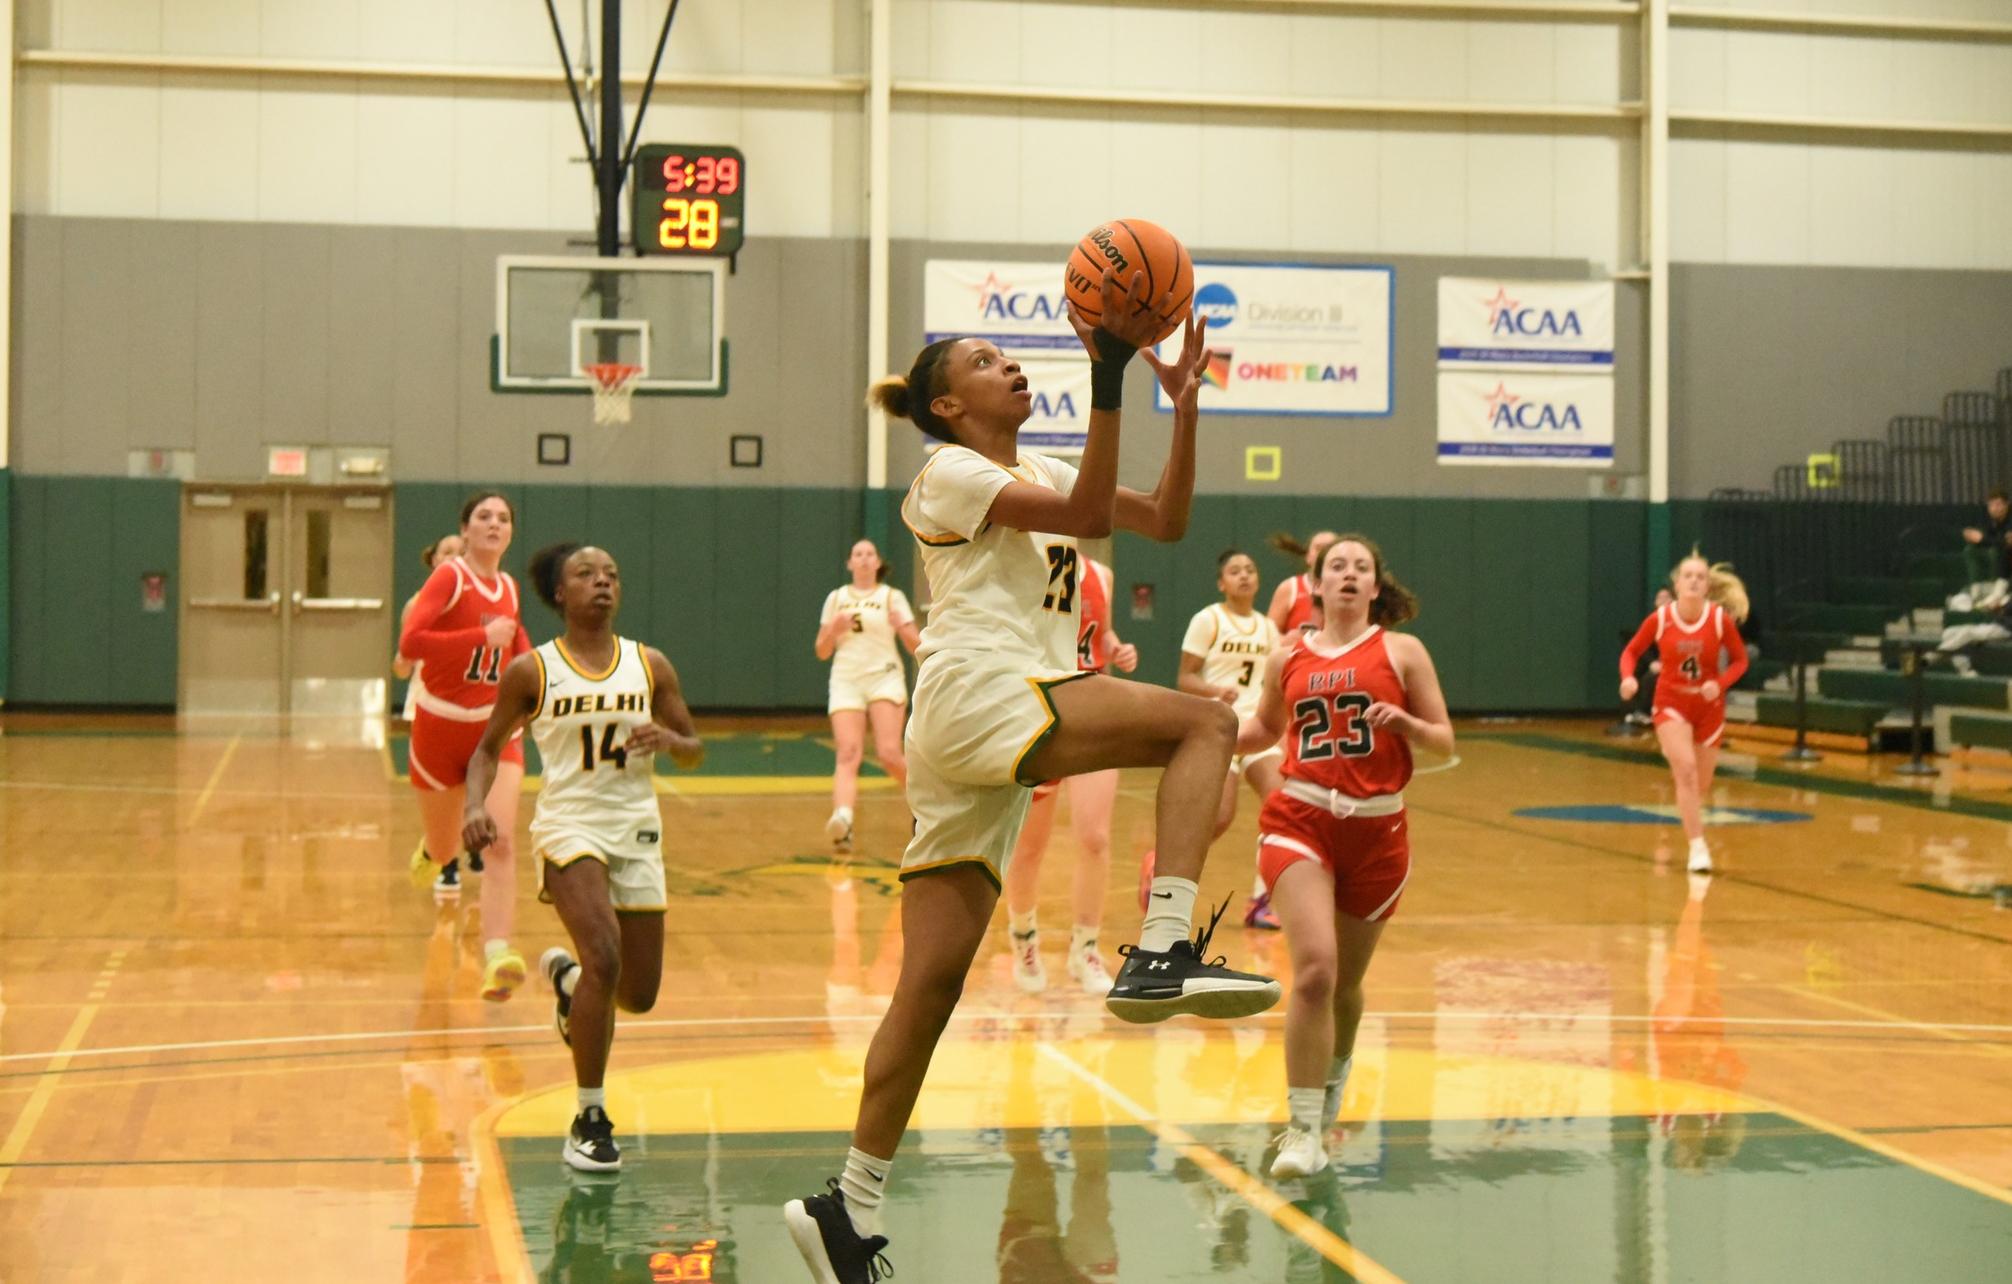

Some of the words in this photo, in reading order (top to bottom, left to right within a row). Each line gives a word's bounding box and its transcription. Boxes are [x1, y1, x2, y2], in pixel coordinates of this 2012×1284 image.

[663, 155, 739, 195] 5:39
[659, 198, 719, 249] 28
[1493, 308, 1583, 336] ACAA
[1237, 363, 1358, 382] ONETEAM
[1494, 403, 1582, 430] ACAA
[1042, 544, 1077, 615] 23
[464, 646, 501, 685] 11
[1238, 660, 1255, 688] 3
[1309, 667, 1356, 692] RPI
[1681, 655, 1701, 680] 4
[552, 693, 644, 718] DELHI
[1296, 692, 1374, 763] 23
[580, 722, 626, 771] 14
